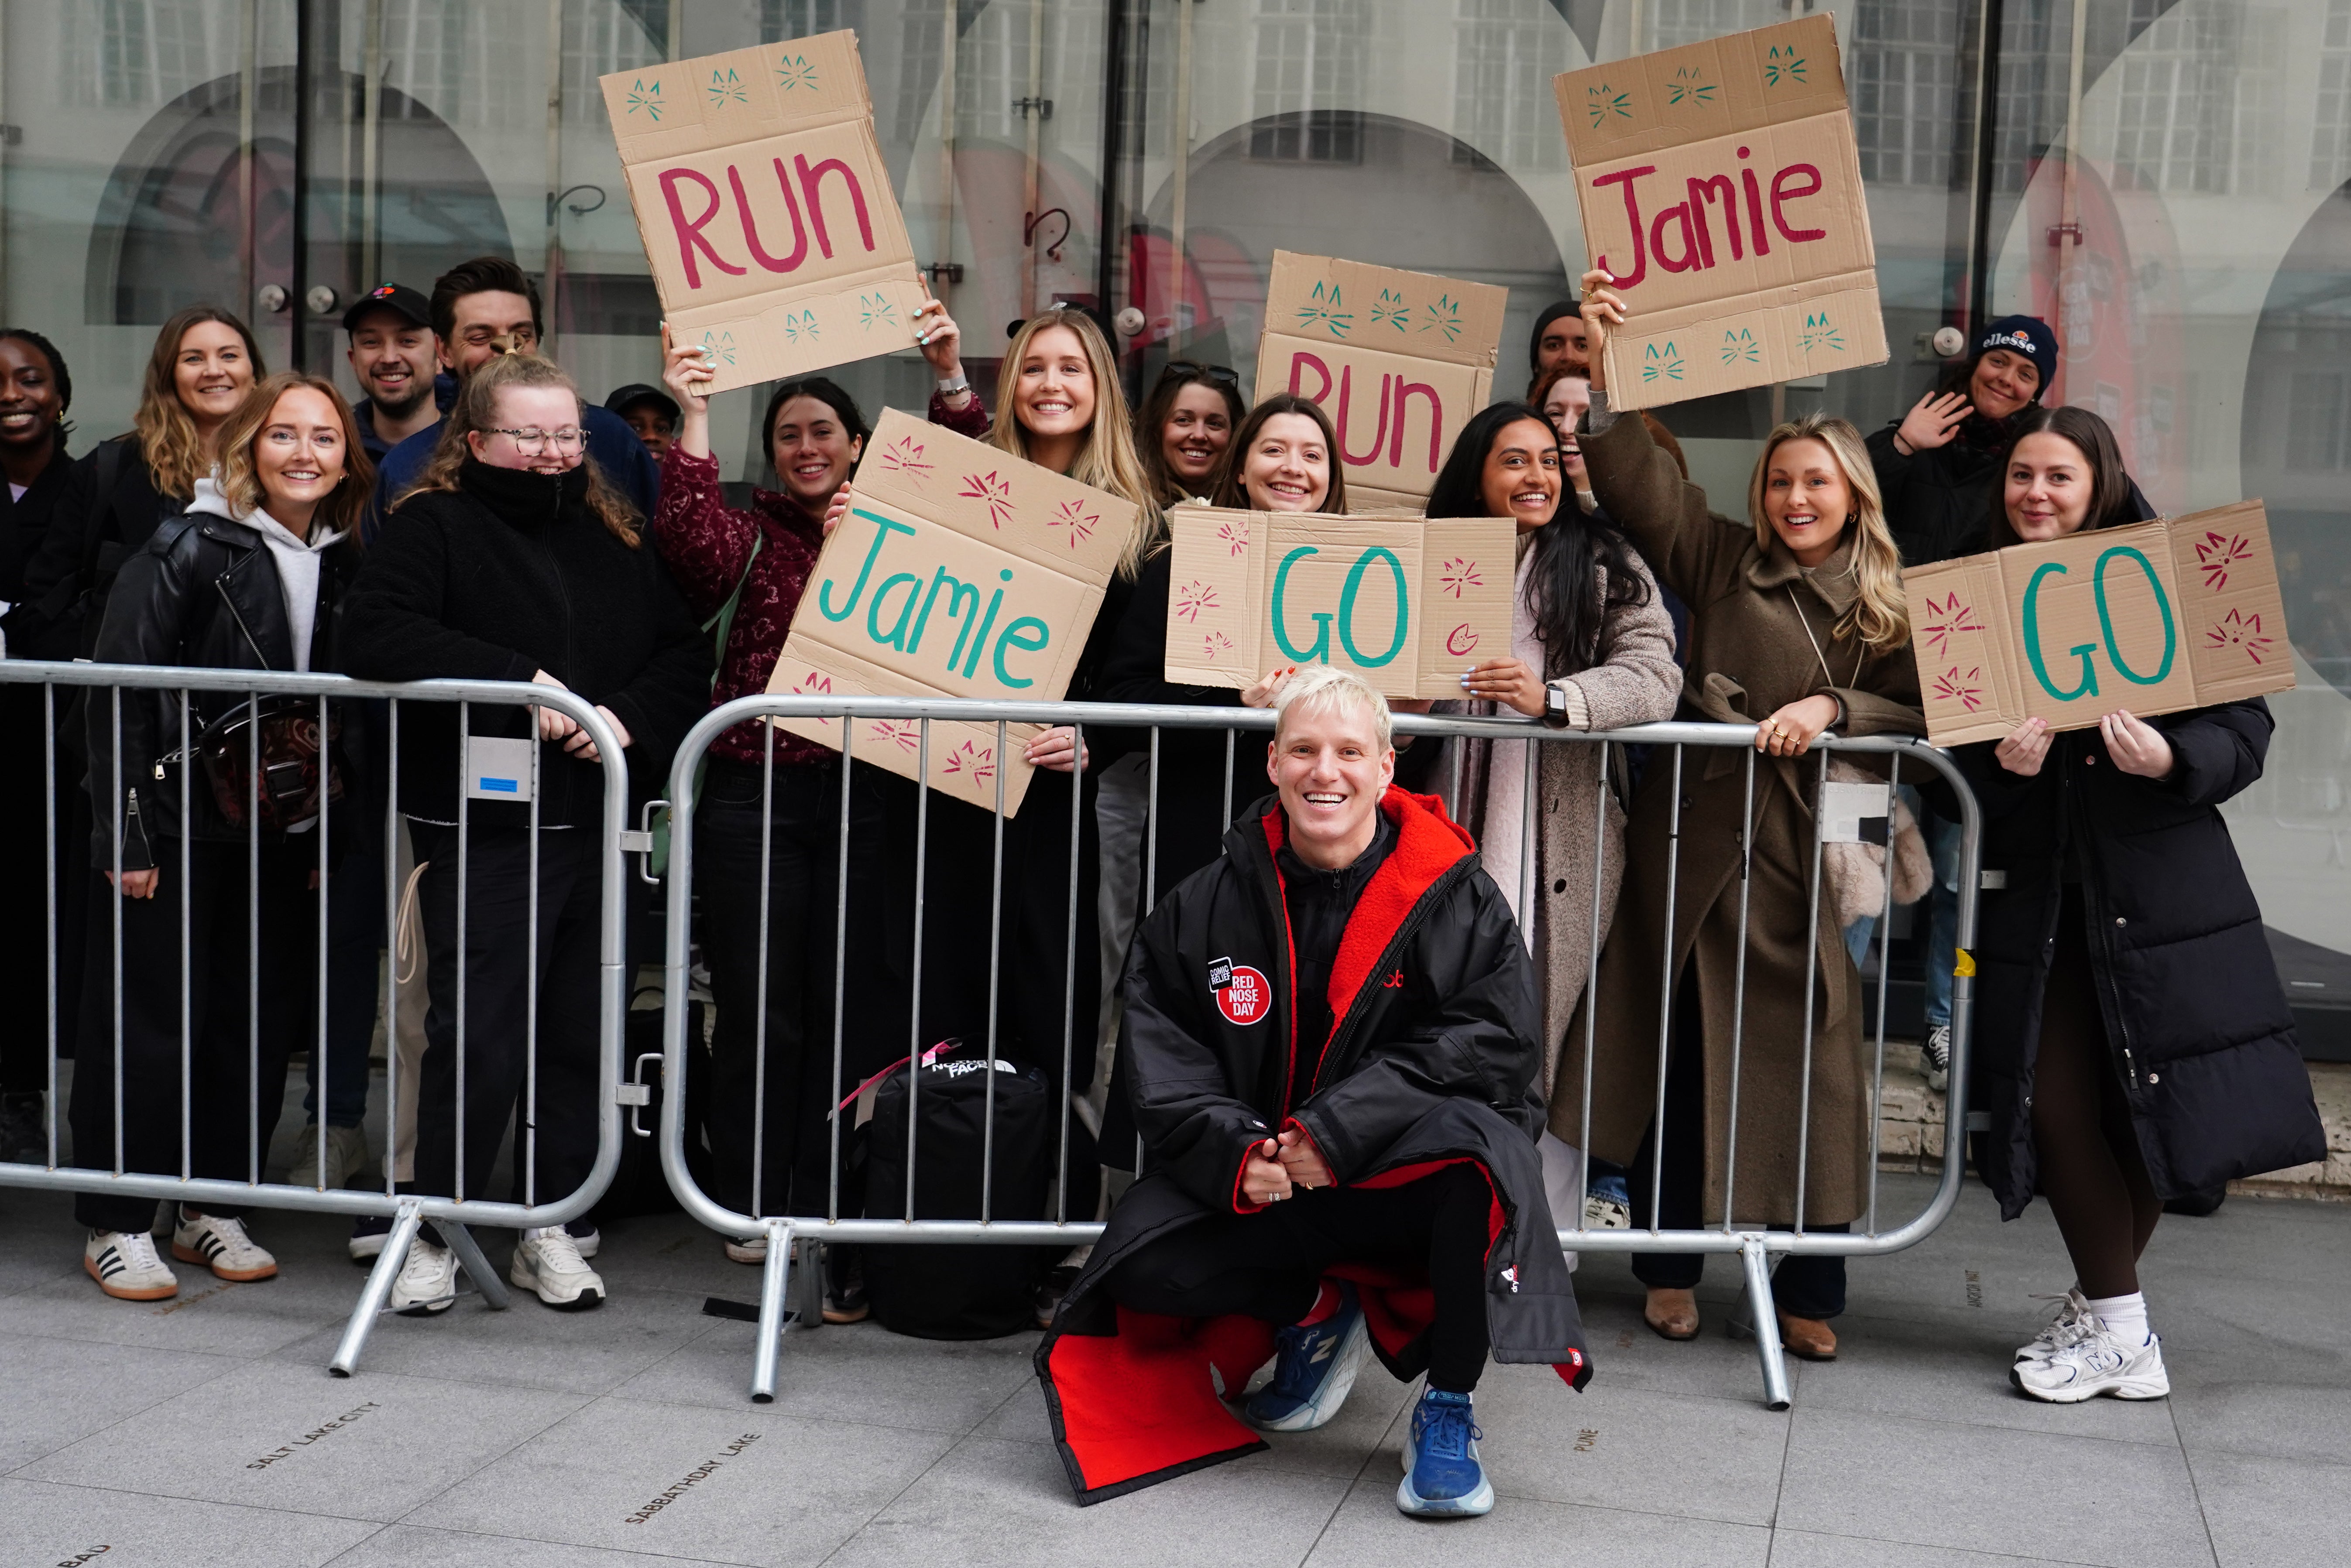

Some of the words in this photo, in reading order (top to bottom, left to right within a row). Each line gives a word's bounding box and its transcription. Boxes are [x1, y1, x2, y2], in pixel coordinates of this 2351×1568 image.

[1593, 146, 1826, 290] Jamie
[1983, 333, 2036, 353] ellesse
[819, 507, 1050, 689] Jamie
[1272, 546, 1409, 668] GO
[2022, 546, 2176, 702] GO
[1210, 965, 1229, 977] COMIC
[1211, 972, 1230, 985] RELIEF
[1232, 976, 1254, 989] RED
[1229, 989, 1259, 1003] NOSE
[1233, 1003, 1255, 1016] DAY
[247, 1446, 297, 1469] SALT
[292, 1422, 346, 1445] LAKE
[338, 1401, 381, 1421] CITY
[1573, 1429, 1599, 1452] PUNE
[625, 1460, 723, 1524] SABBATHDAY
[717, 1433, 762, 1456] LAKE
